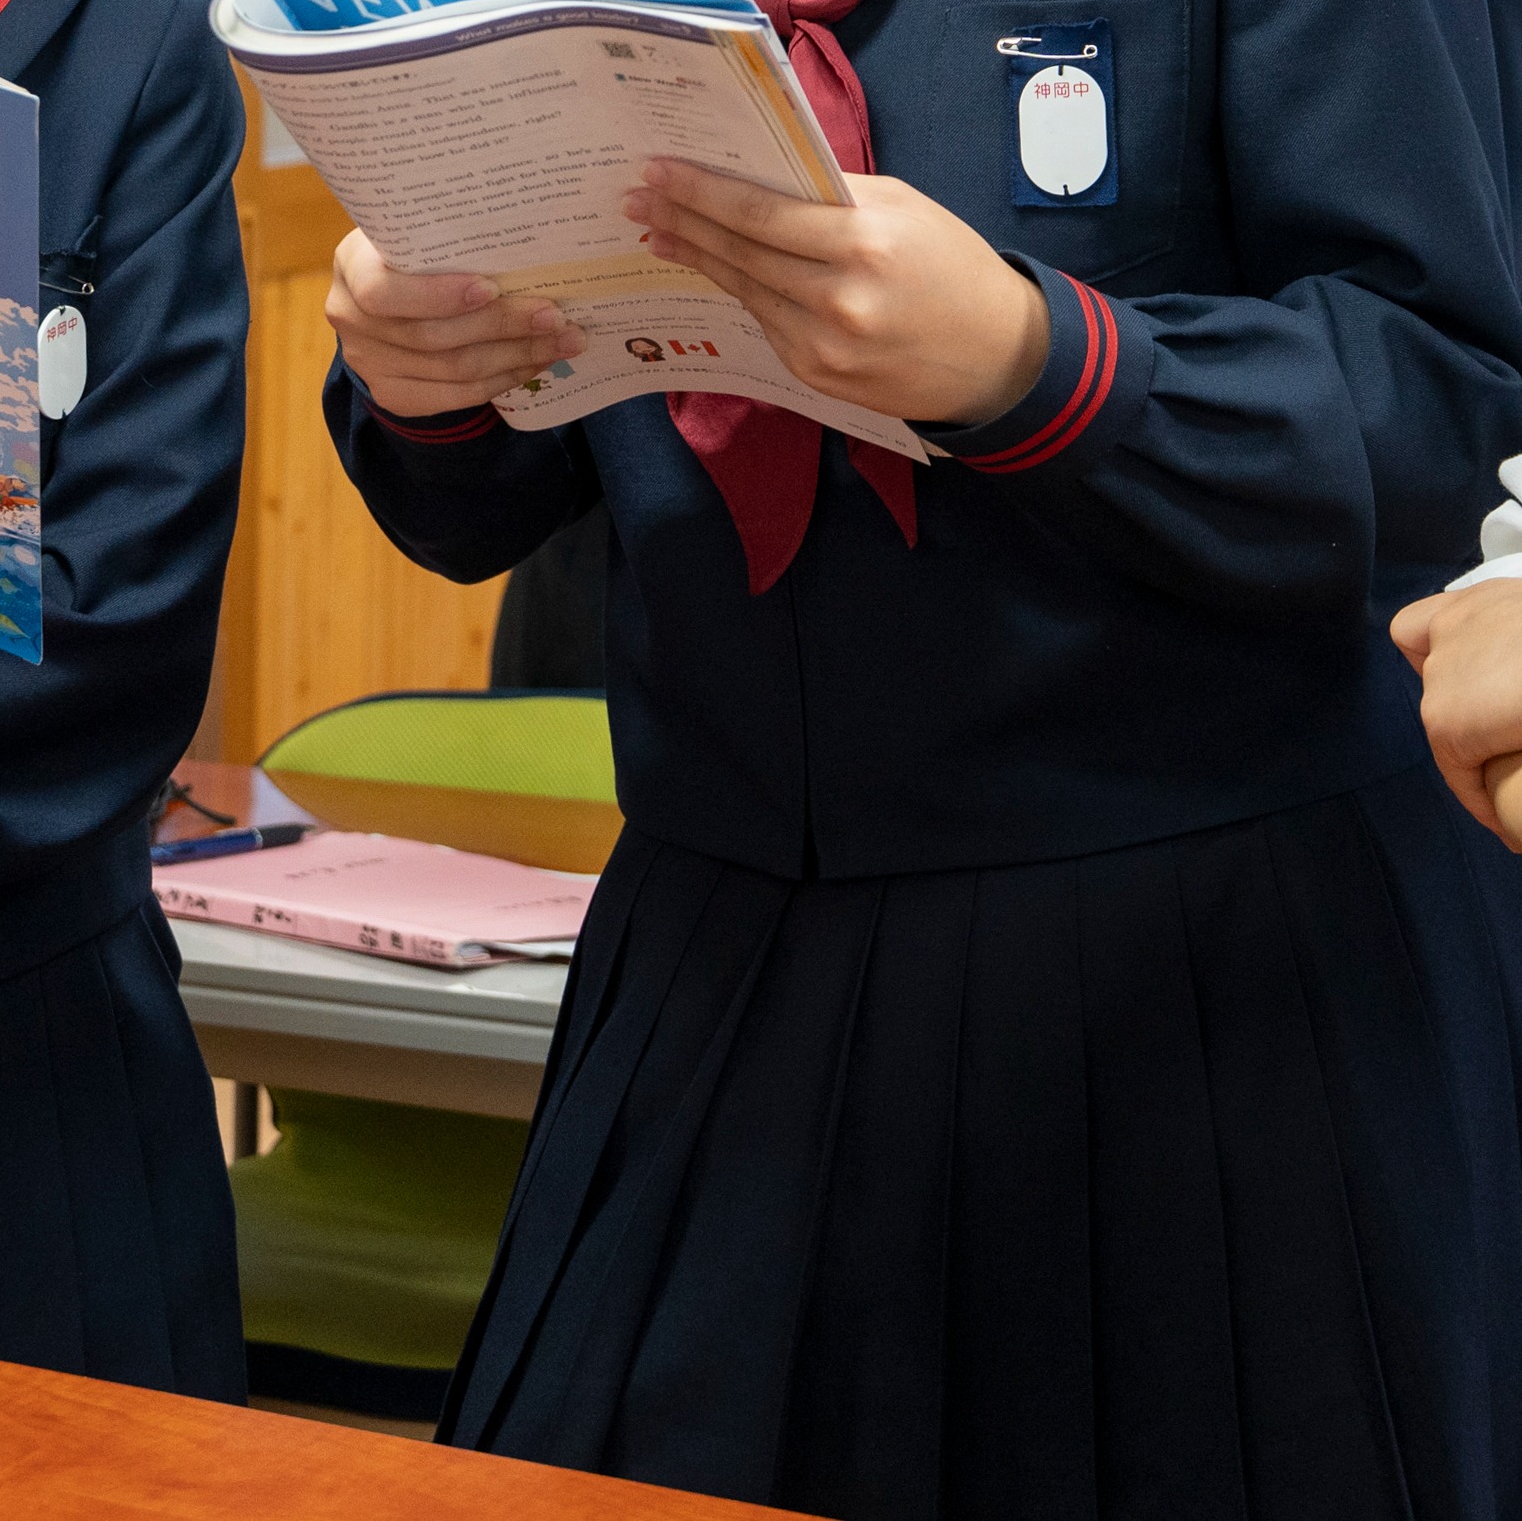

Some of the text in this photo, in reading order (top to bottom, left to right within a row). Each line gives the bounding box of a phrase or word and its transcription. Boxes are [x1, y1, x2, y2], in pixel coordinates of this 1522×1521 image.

[422, 92, 455, 105] That
[460, 86, 486, 97] was
[490, 69, 566, 91] interesting.
[448, 102, 481, 114] who
[509, 79, 578, 101] influenced
[1033, 81, 1090, 100] 神岡中
[421, 123, 442, 133] the
[524, 110, 562, 126] right?
[355, 163, 377, 173] you
[381, 156, 416, 169] know
[418, 151, 446, 162] how
[448, 147, 467, 156] he
[469, 140, 491, 151] did
[494, 135, 510, 146] it?
[402, 181, 437, 192] never
[445, 171, 475, 183] used
[482, 157, 538, 176] violence,
[545, 153, 560, 162] so
[599, 143, 625, 154] still
[393, 209, 426, 220] want
[428, 204, 442, 213] to
[444, 197, 478, 210] learn
[481, 189, 514, 202] more
[517, 181, 553, 194] about
[557, 175, 586, 186] him.
[413, 190, 454, 205] people
[456, 183, 483, 195] who
[486, 176, 516, 189] fight
[519, 170, 539, 180] for
[541, 162, 587, 176] human
[591, 157, 633, 169] rights.
[405, 221, 432, 232] also
[434, 211, 467, 224] went
[468, 209, 485, 217] on
[487, 201, 520, 214] fasts
[521, 196, 535, 205] to
[538, 188, 587, 203] protest.
[419, 253, 452, 265] That
[454, 242, 498, 258] sounds
[500, 235, 540, 249] tough.
[421, 212, 603, 253] means eating little or no food.
[534, 279, 560, 290] who
[562, 276, 584, 286] has
[586, 269, 644, 285] influenced
[657, 267, 672, 275] lot
[46, 316, 79, 343] 神岡中
